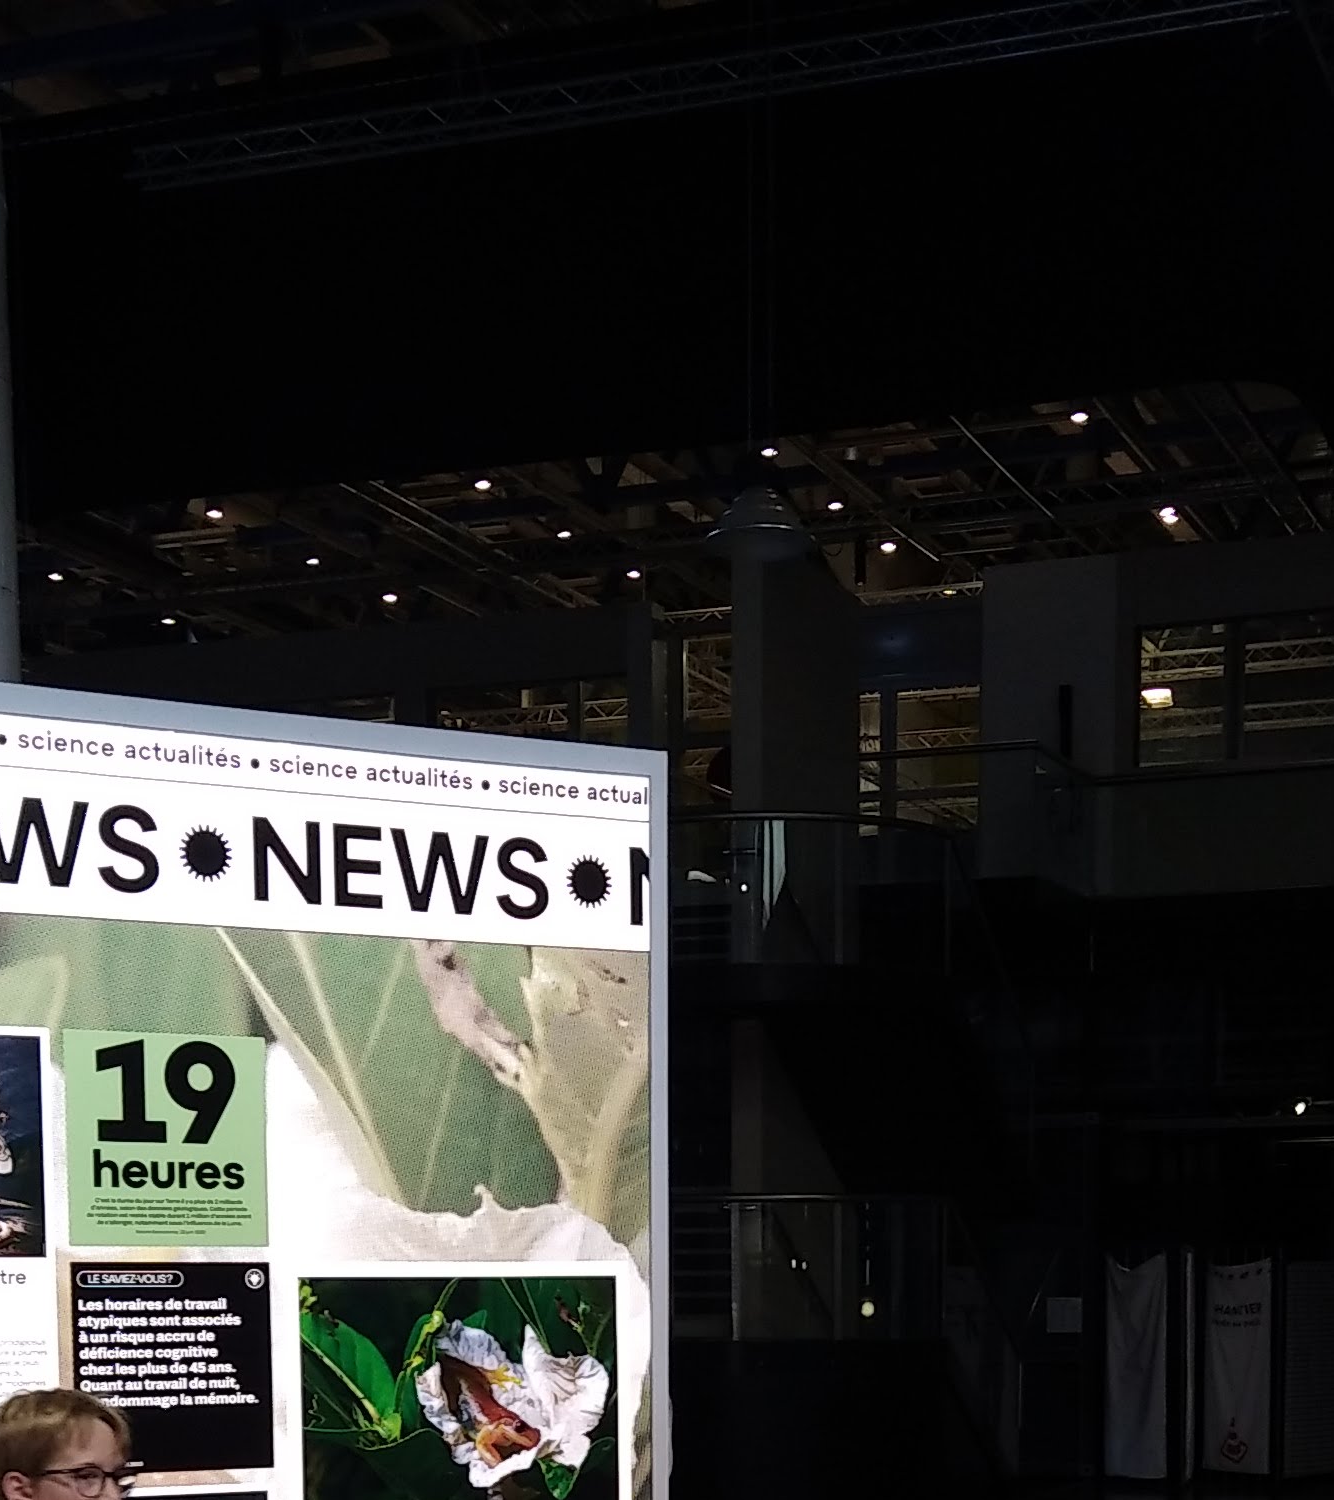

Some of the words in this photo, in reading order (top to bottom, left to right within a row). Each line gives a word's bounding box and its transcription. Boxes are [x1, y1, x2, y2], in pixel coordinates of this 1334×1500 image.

[18, 730, 115, 757] science
[125, 743, 241, 768] actualités
[270, 755, 357, 780] science
[367, 766, 473, 790] actualités
[499, 776, 579, 799] science
[253, 816, 549, 920] NEWS
[95, 1039, 236, 1144] 19
[93, 1148, 245, 1190] heures
[88, 1274, 102, 1283] LE
[77, 1299, 103, 1310] Les
[105, 1298, 162, 1310] horaires
[164, 1298, 182, 1310] de
[184, 1297, 227, 1310] travail
[77, 1314, 147, 1329] atypiques
[149, 1315, 180, 1326] sont
[182, 1313, 241, 1326] associés
[78, 1346, 153, 1359] déficience
[155, 1345, 218, 1360] cognitive
[79, 1362, 113, 1375] chez
[115, 1362, 136, 1374] les
[138, 1362, 167, 1376] plus
[169, 1361, 187, 1373] de
[189, 1361, 206, 1373] 45
[207, 1363, 236, 1372] ans.
[79, 1379, 123, 1392] Quant
[124, 1380, 142, 1390] au
[143, 1377, 187, 1390] travail
[188, 1377, 207, 1389] de
[208, 1376, 239, 1390] nuit,
[98, 1393, 178, 1410] ndommage
[179, 1393, 193, 1405] la
[194, 1391, 259, 1404] mémoire.
